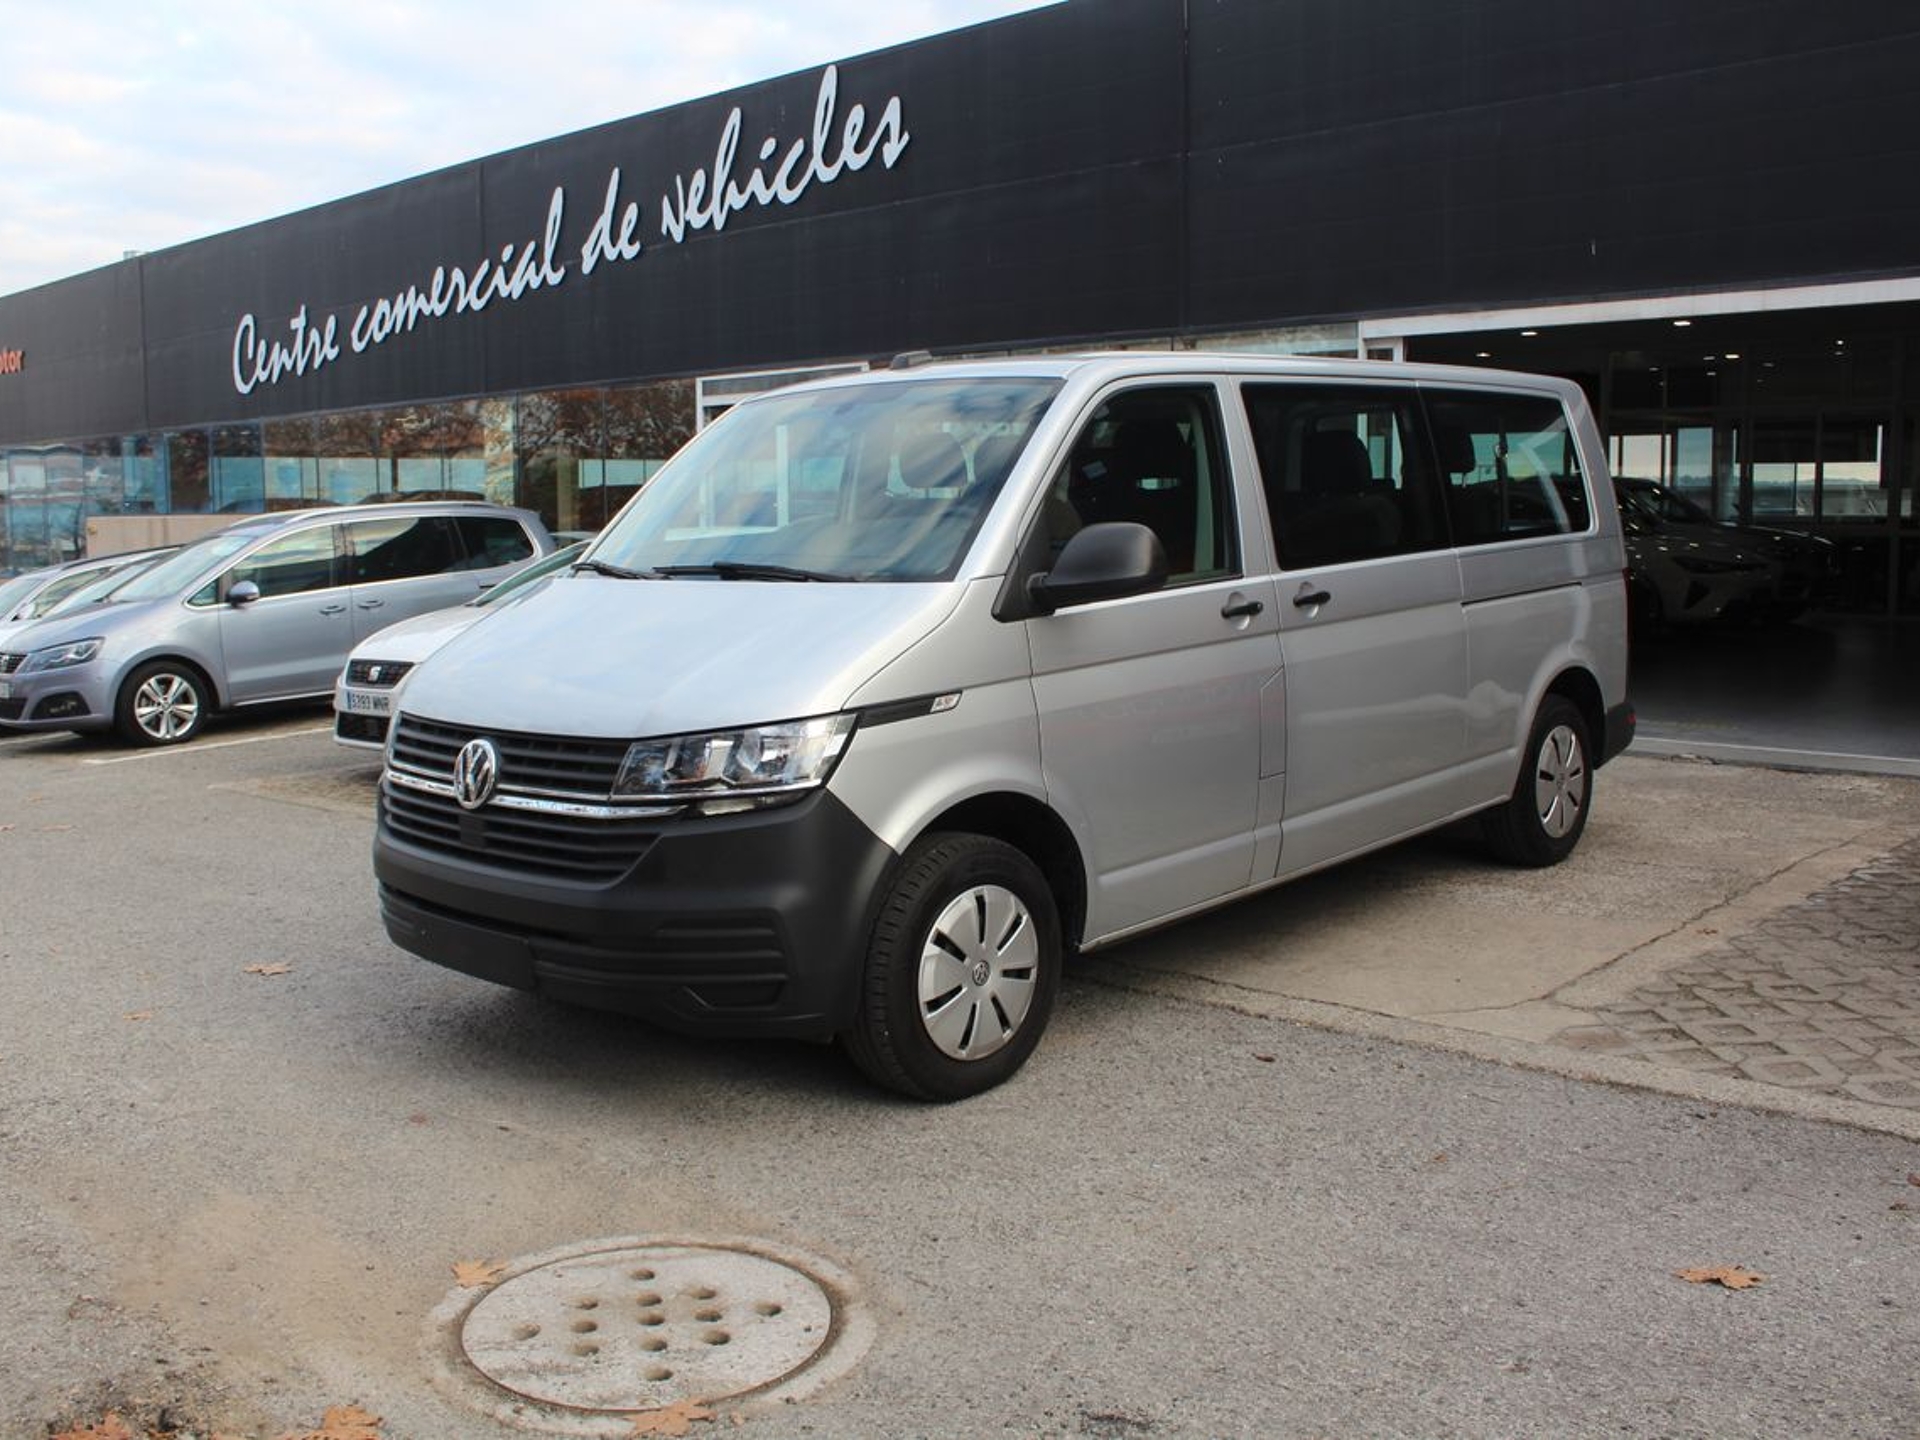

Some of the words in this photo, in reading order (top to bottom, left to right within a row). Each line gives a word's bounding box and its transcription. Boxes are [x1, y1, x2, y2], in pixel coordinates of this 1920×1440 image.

[232, 304, 340, 394] Centre
[350, 186, 566, 353] comercial
[581, 166, 641, 275] de
[661, 64, 910, 243] vehicles
